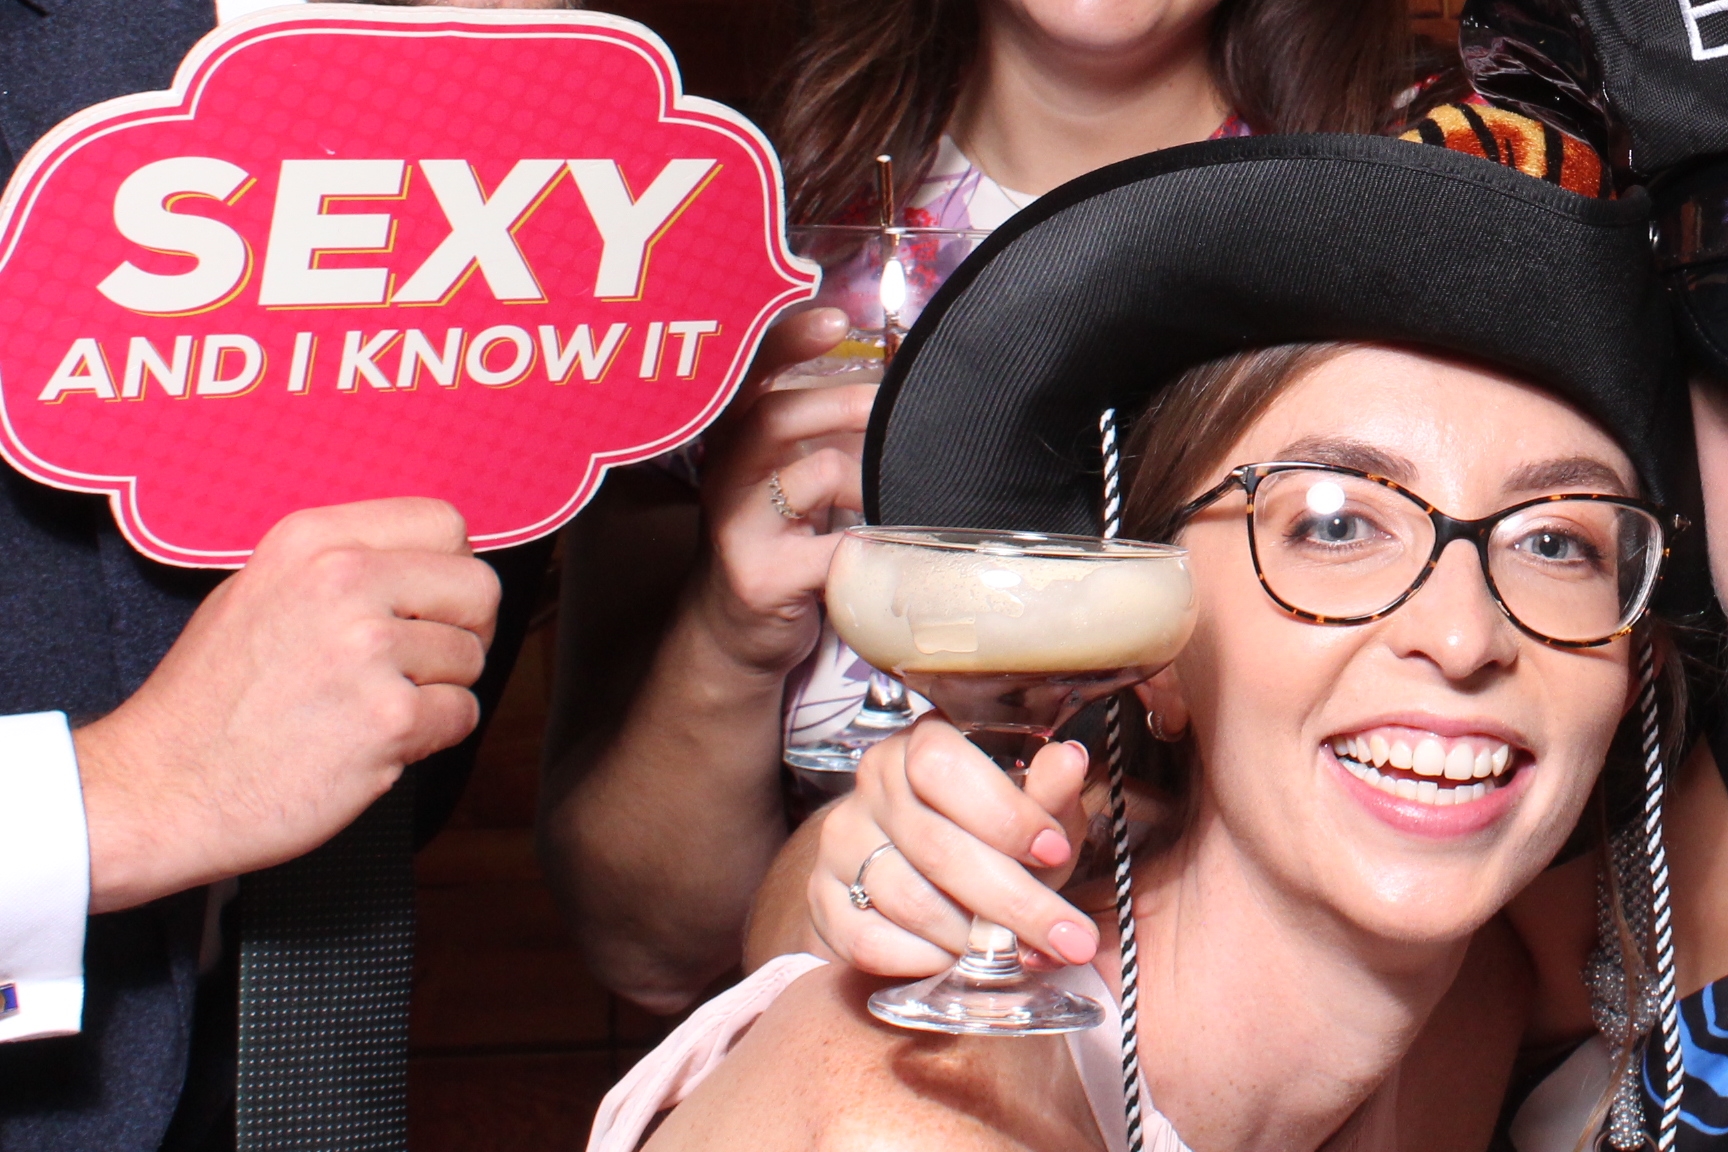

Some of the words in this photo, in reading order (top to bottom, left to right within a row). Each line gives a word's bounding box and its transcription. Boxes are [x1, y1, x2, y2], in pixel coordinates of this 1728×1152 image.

[97, 155, 723, 318] SEXY
[38, 333, 267, 403] AND
[287, 332, 317, 395] I
[336, 322, 630, 391] KNOW
[638, 319, 722, 382] IT
